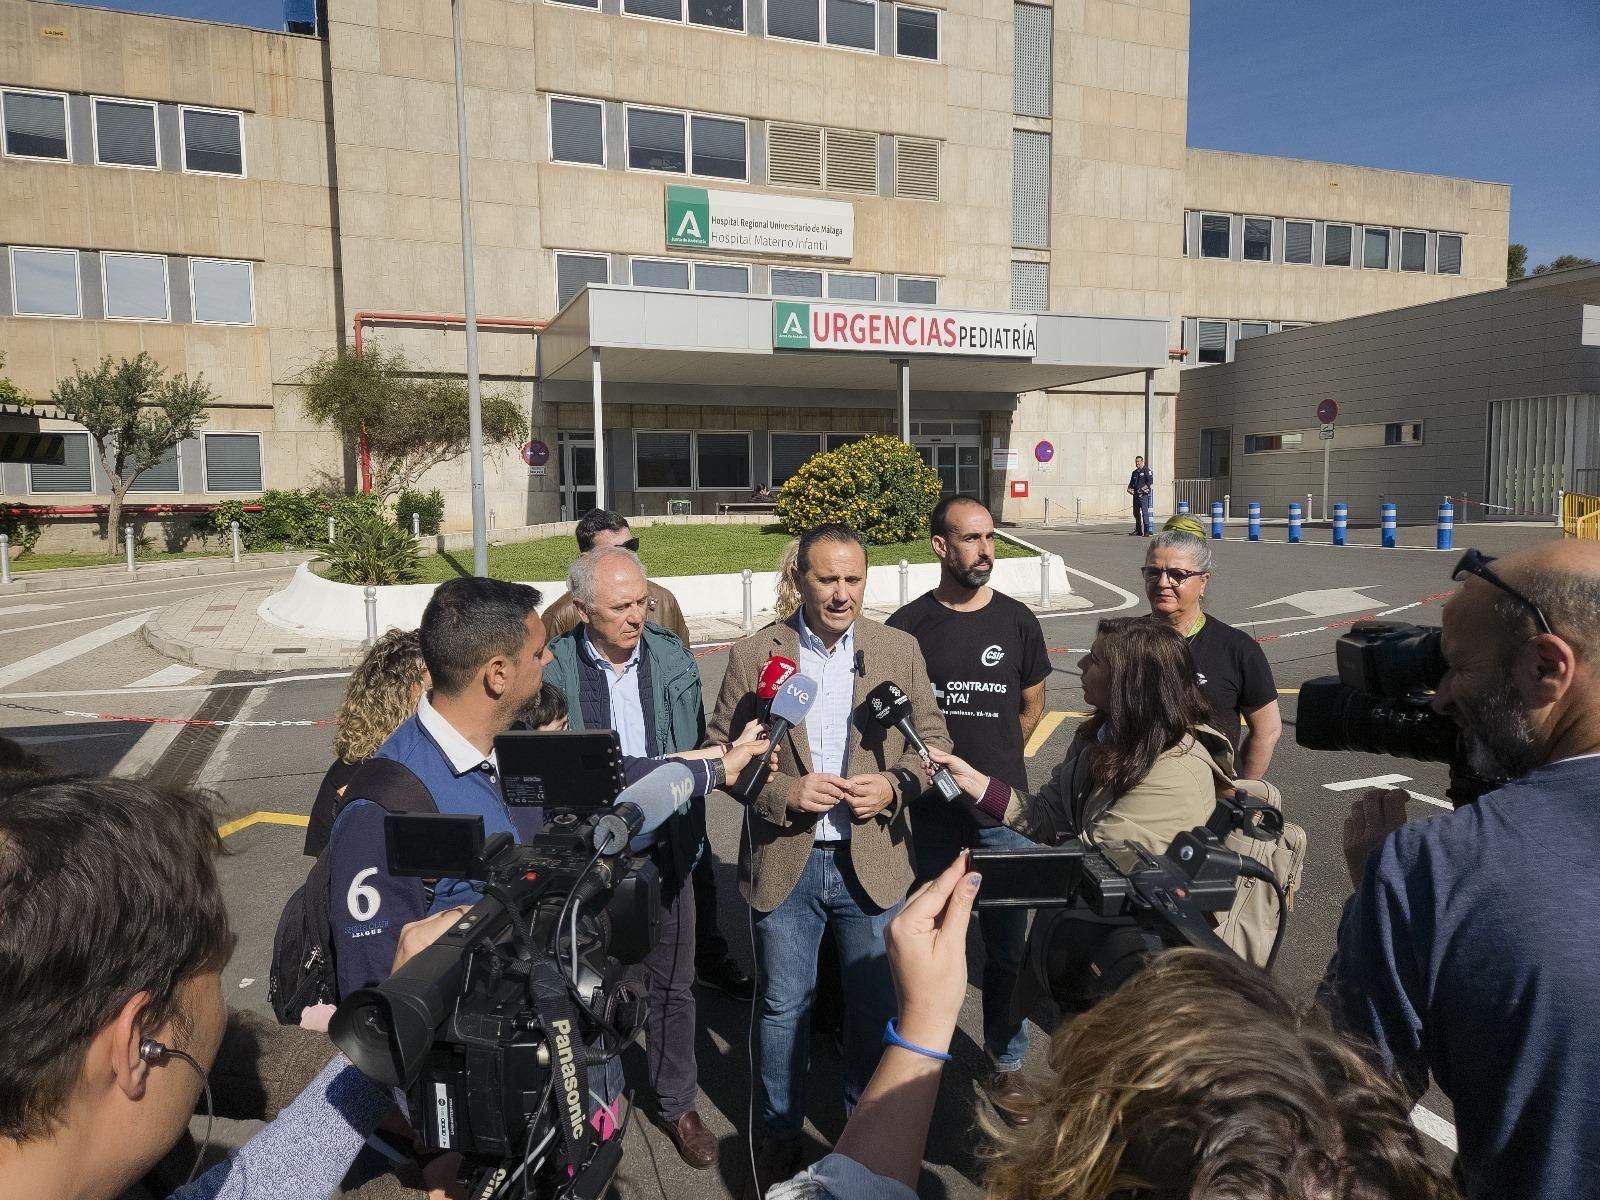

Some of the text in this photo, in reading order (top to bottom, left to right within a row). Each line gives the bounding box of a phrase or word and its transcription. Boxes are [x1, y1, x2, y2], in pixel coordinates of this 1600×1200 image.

[711, 216, 843, 237] Hospital Regional Universitario de Málaga
[711, 231, 828, 251] Hospital Materno Infantil
[813, 311, 1036, 351] URGENCIAS PEDIATRÍA
[787, 683, 809, 705] tve
[946, 681, 1007, 694] CONTRATOS
[946, 693, 970, 705] ¡YA!
[347, 866, 381, 922] 6
[351, 928, 382, 938] LEAGUE
[552, 1019, 586, 1140] Panasonic
